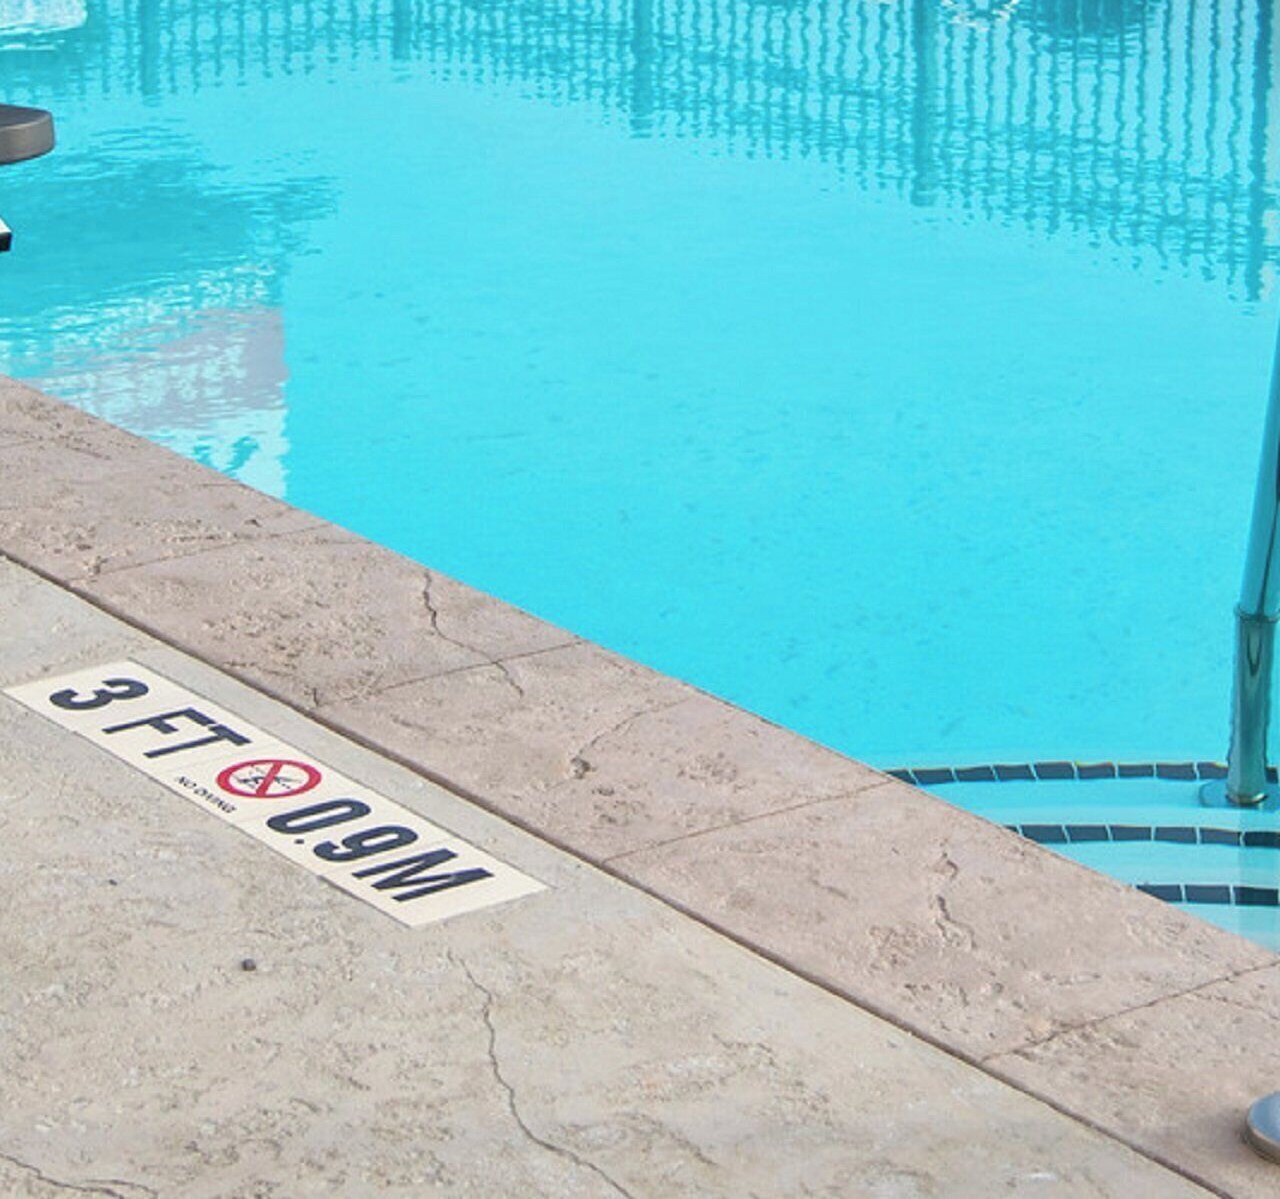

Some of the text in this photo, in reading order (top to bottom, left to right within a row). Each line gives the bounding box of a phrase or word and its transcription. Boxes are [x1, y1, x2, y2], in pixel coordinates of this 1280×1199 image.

[48, 676, 494, 903] 3 FT 0.9M
